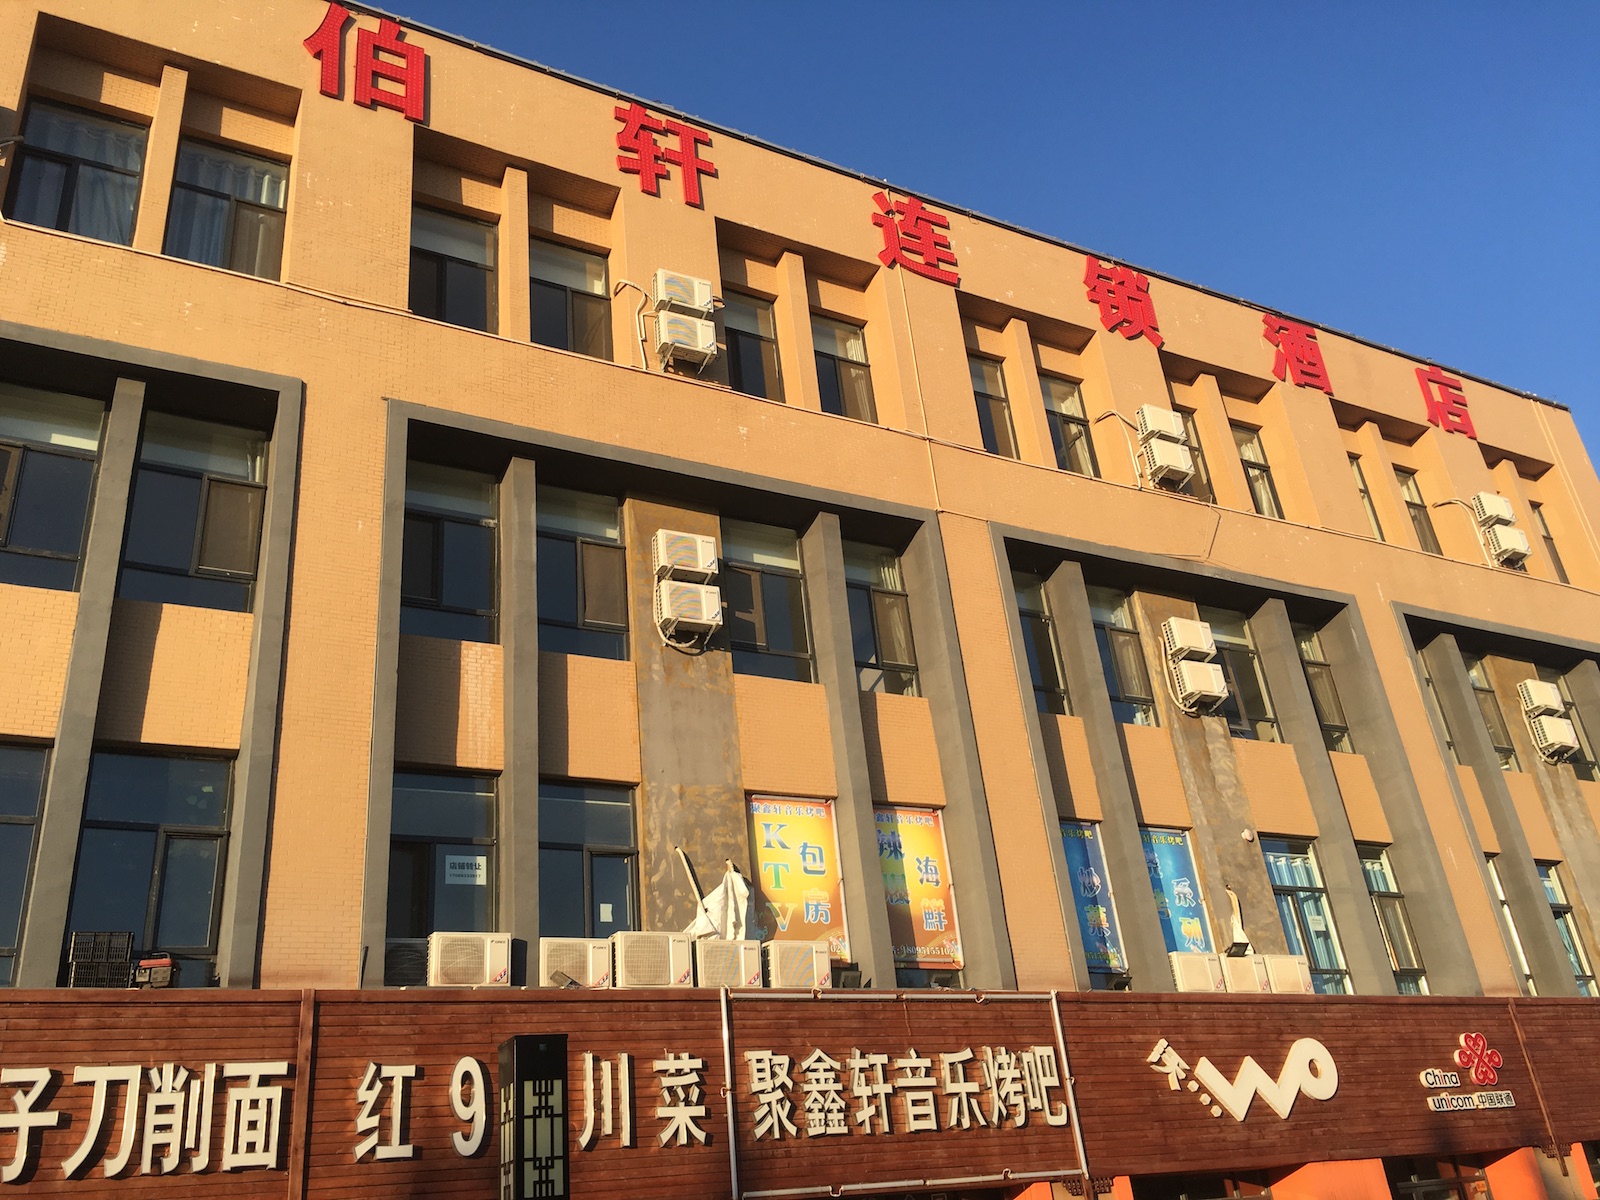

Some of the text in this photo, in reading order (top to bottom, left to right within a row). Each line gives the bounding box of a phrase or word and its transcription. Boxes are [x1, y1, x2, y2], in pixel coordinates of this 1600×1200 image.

[303, 2, 1477, 440] 伯轩连锁酒店
[750, 802, 826, 818] 聚鑫轩音乐烤吧
[761, 822, 798, 932] KTV
[799, 842, 831, 925] 包房
[744, 1046, 1068, 1141] 聚鑫轩音乐烤吧
[1425, 1068, 1459, 1086] China
[1433, 1091, 1514, 1110] unicom 中国联通
[0, 1061, 289, 1184] 子刀削面
